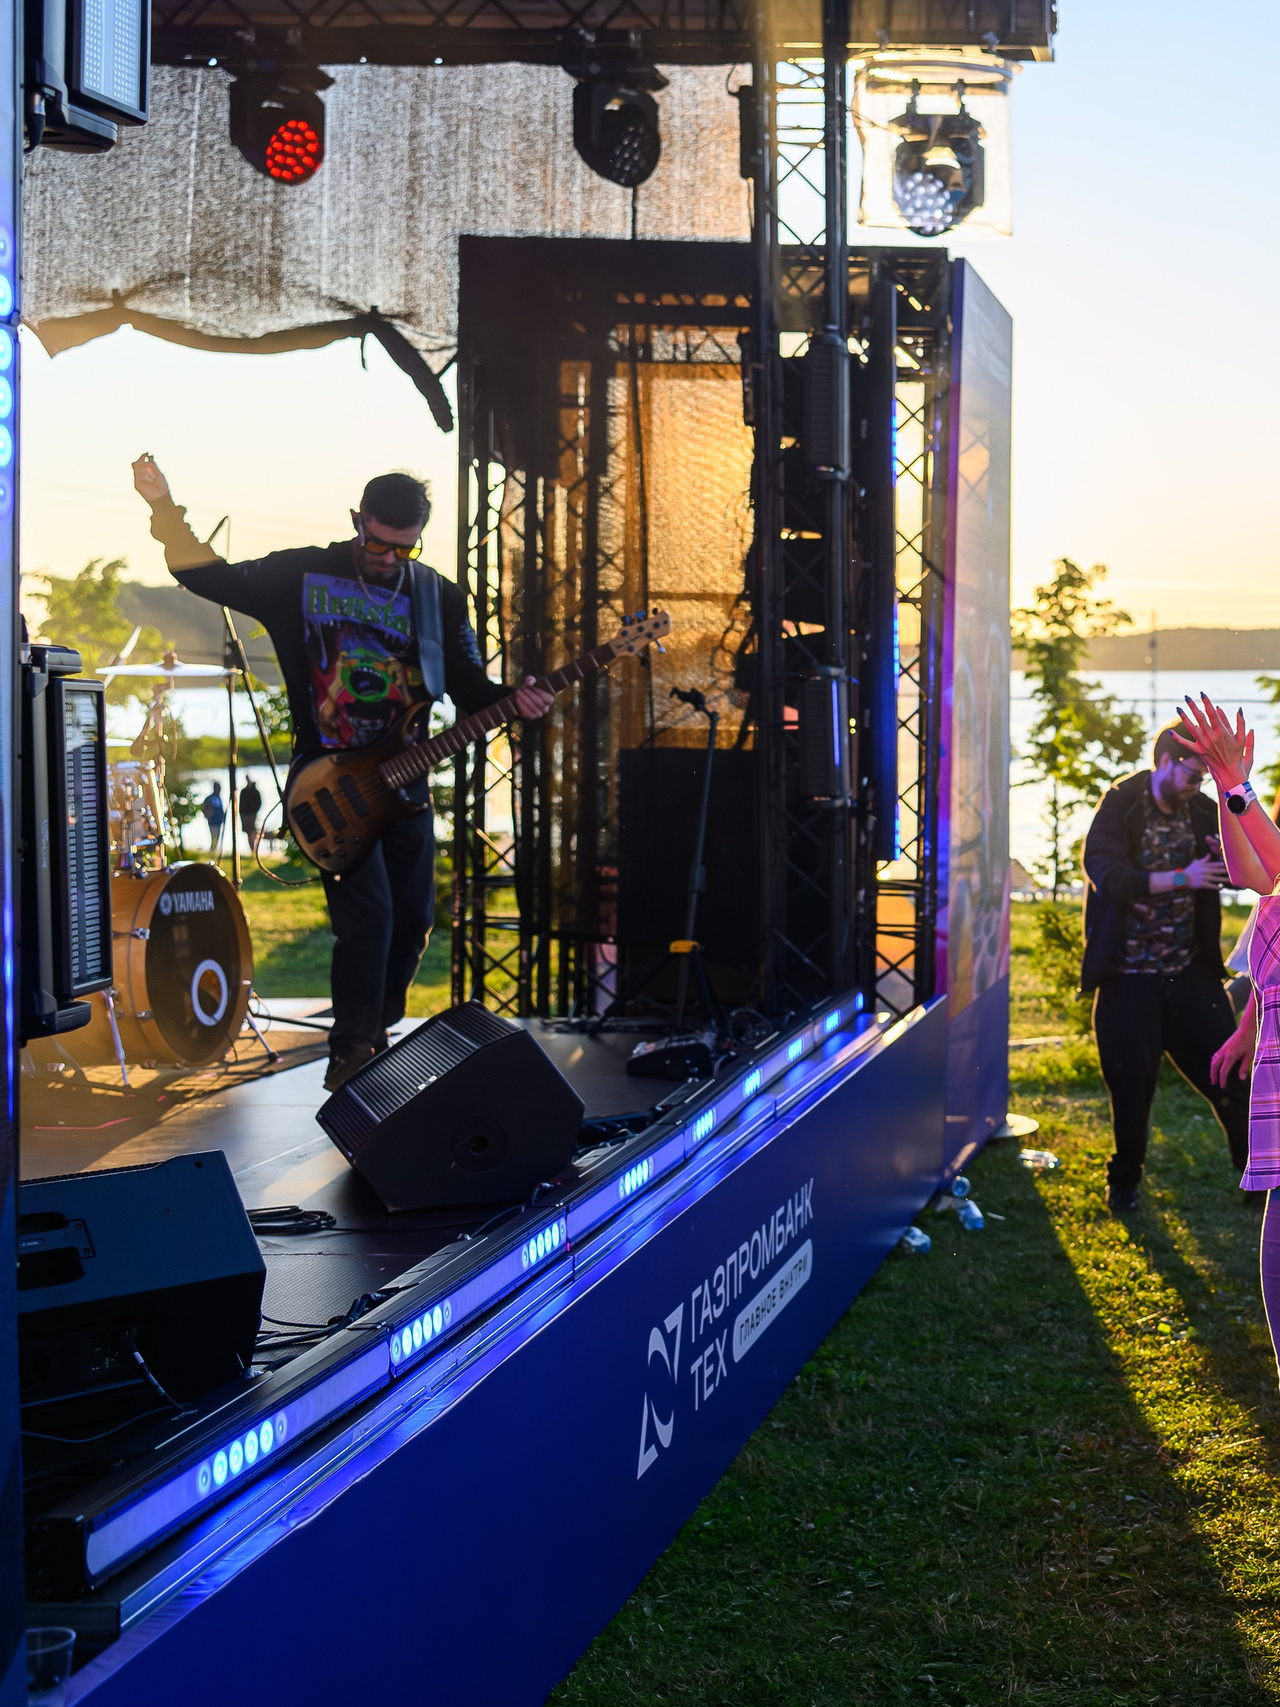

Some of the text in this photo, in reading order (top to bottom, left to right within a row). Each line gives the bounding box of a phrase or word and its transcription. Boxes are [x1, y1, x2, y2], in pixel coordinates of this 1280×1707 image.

[173, 890, 215, 913] YAMAHA
[691, 1177, 814, 1343] ГАЗПРОМБАНК
[739, 1253, 808, 1346] ГЛАВНОЕ ВНУТРИ
[691, 1328, 728, 1411] ТЕХ
